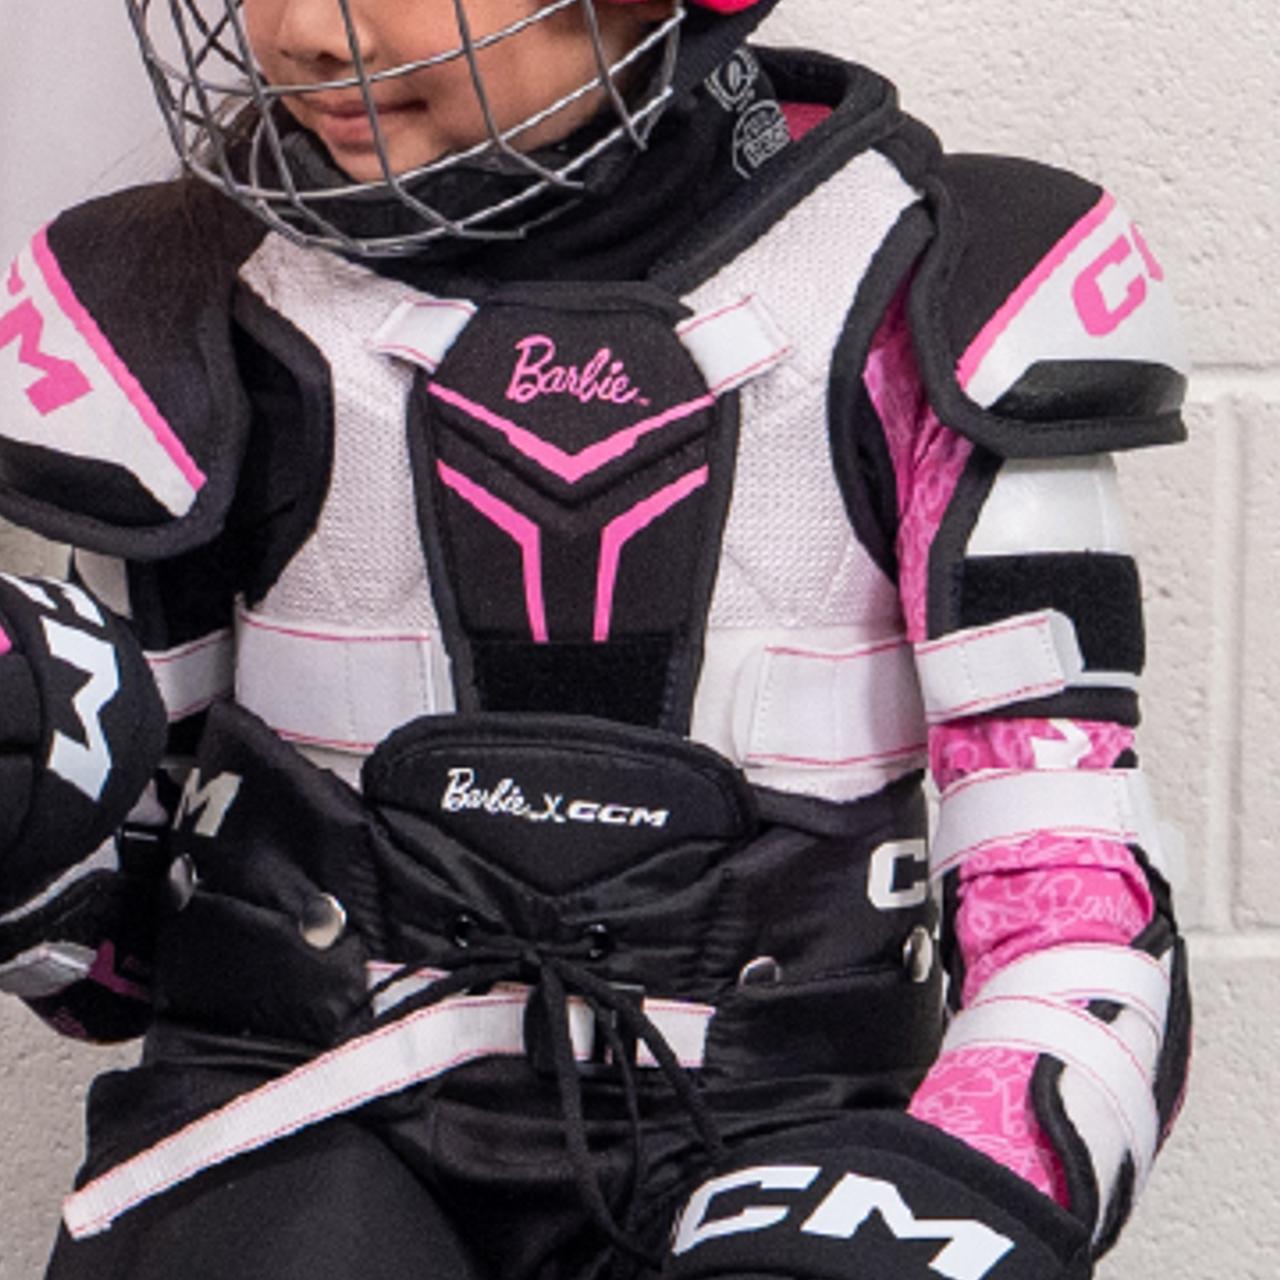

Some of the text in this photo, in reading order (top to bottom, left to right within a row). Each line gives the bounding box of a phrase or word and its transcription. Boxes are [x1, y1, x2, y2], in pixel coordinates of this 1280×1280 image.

[505, 334, 640, 403] Barbie
[442, 767, 530, 815] Barbie
[567, 800, 669, 827] CCM
